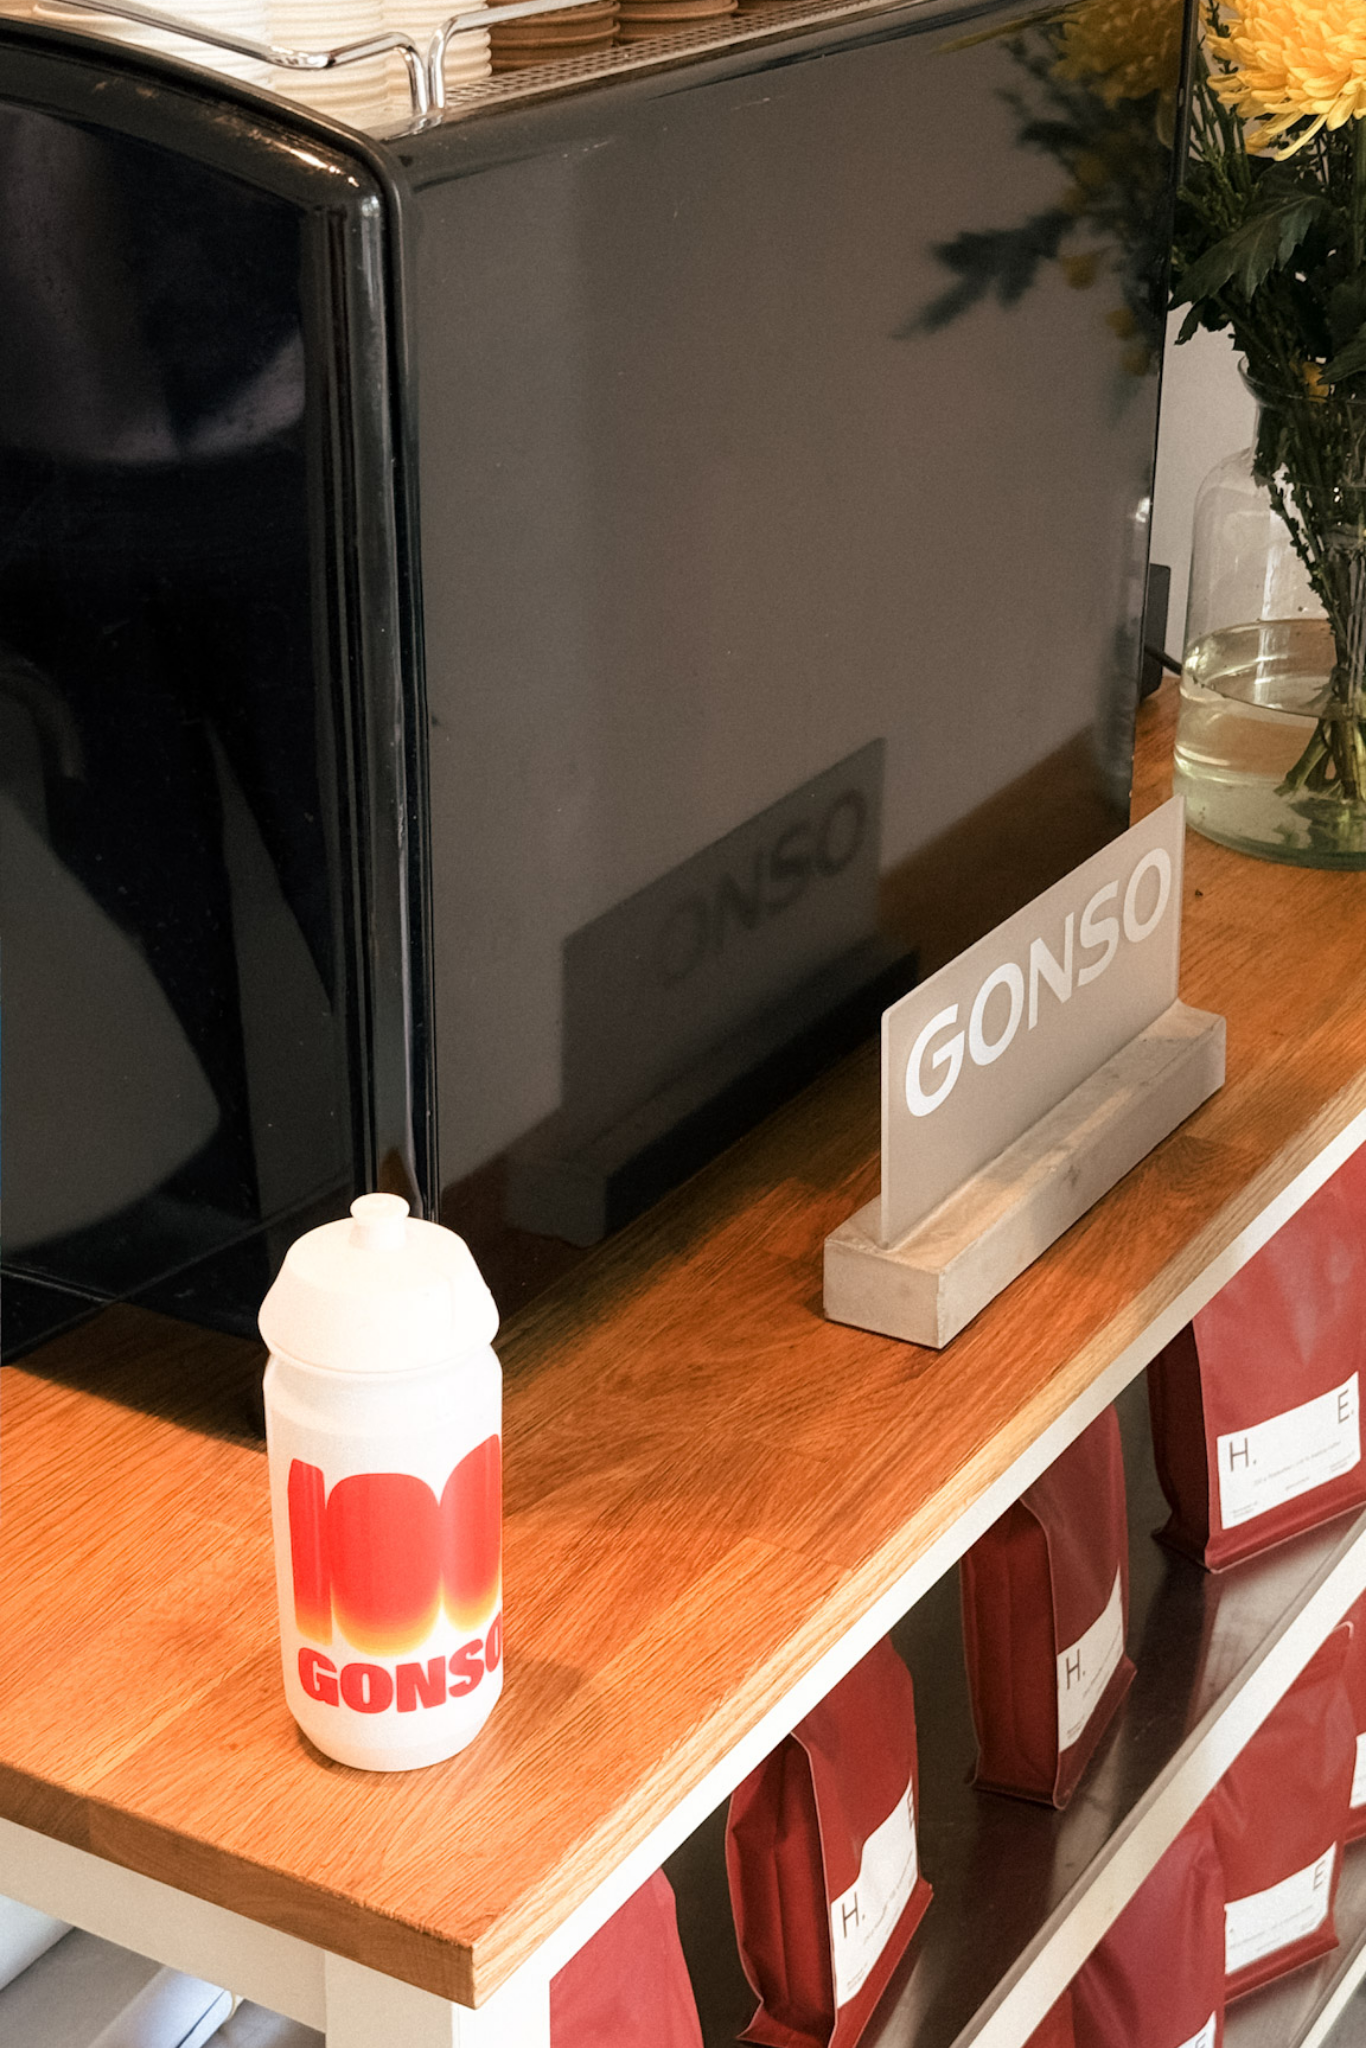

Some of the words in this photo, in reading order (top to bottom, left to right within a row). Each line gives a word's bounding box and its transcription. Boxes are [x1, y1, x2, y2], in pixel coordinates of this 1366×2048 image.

[655, 785, 869, 990] ONSO
[905, 847, 1172, 1118] GONSO
[1229, 1436, 1258, 1473] H.
[298, 1611, 501, 1715] GONSO
[1065, 1648, 1087, 1691] H.
[841, 1890, 867, 1939] H.
